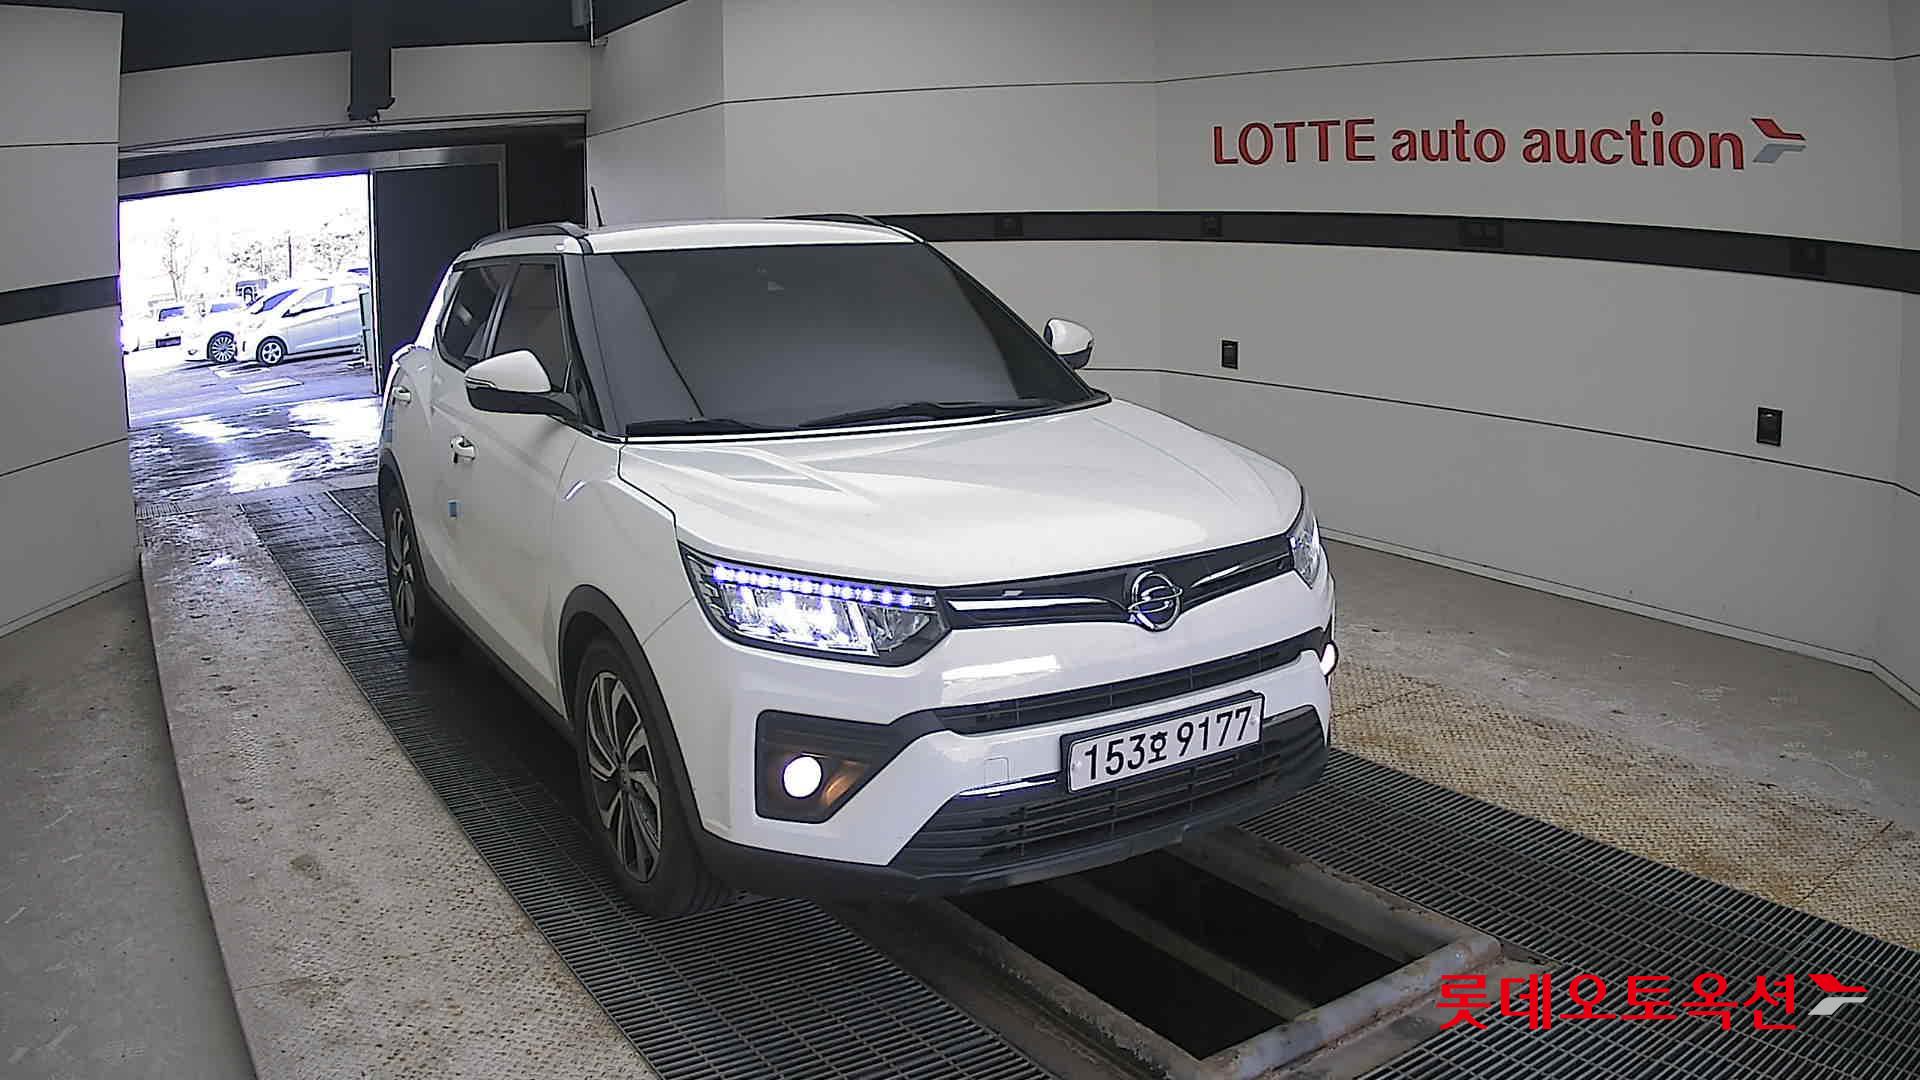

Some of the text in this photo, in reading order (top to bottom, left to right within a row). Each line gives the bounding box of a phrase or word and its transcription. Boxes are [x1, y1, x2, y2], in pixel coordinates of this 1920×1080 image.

[1213, 111, 1745, 170] LOTTE auto auction
[1084, 705, 1253, 780] 153호 9177
